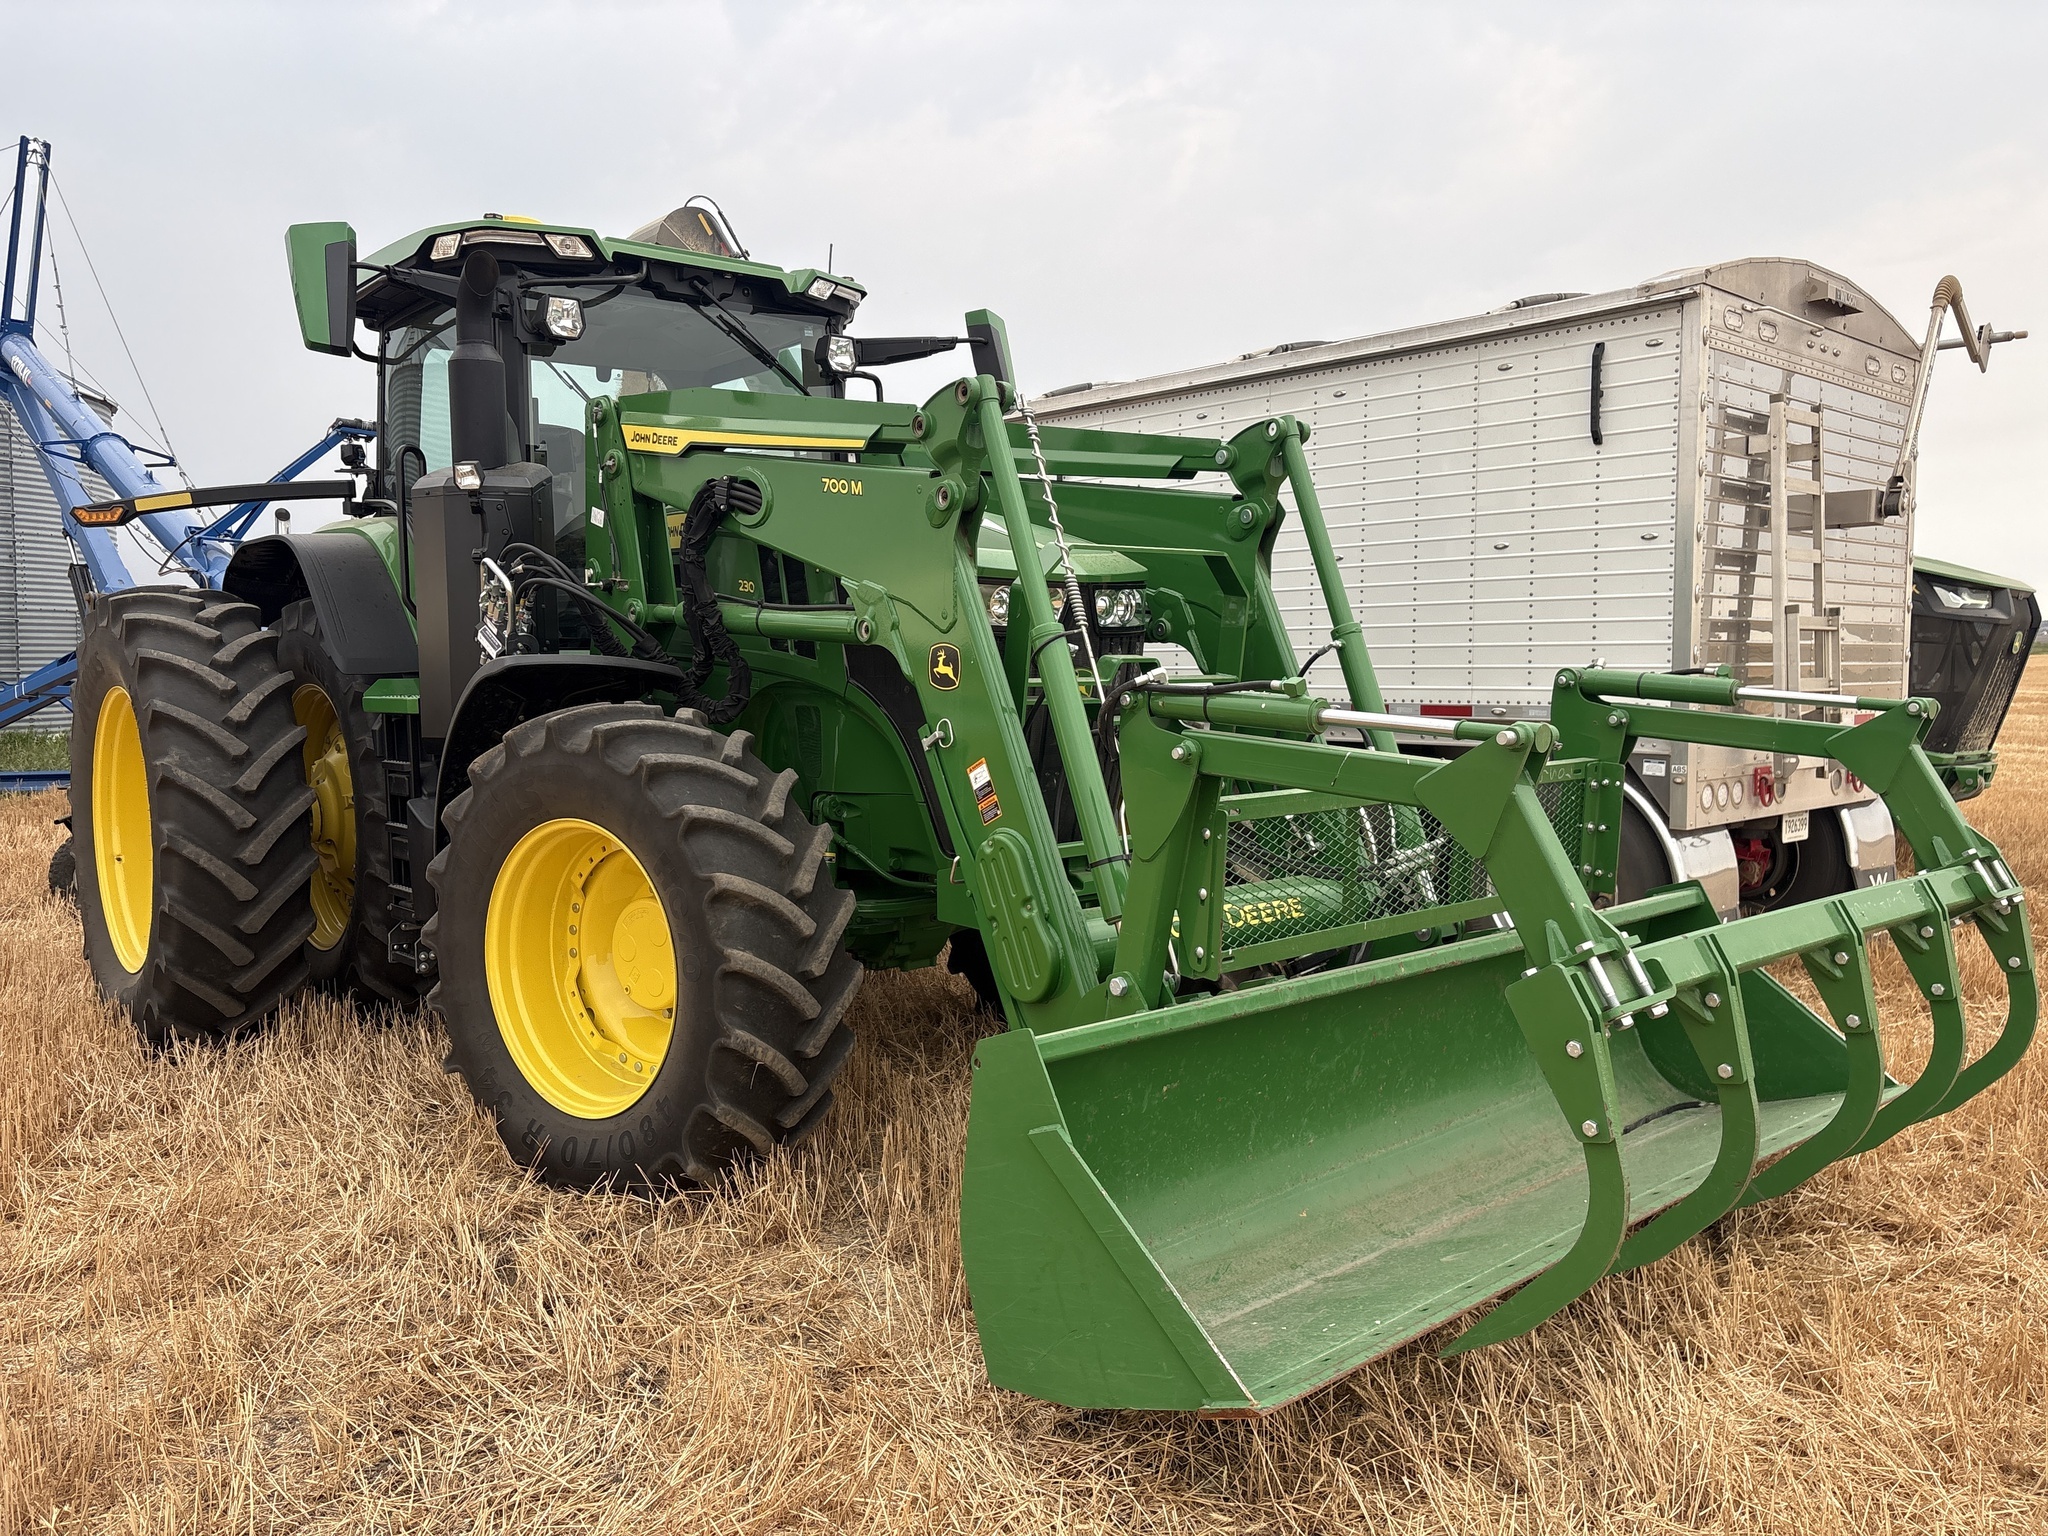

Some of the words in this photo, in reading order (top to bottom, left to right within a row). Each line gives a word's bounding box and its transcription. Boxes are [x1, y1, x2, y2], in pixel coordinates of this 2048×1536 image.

[631, 430, 651, 444] JOHN
[652, 432, 678, 446] DEERE
[821, 476, 849, 495] 700
[850, 479, 863, 496] M
[738, 580, 755, 593] 230
[1672, 765, 1686, 774] ABS
[1222, 897, 1305, 928] DEERE
